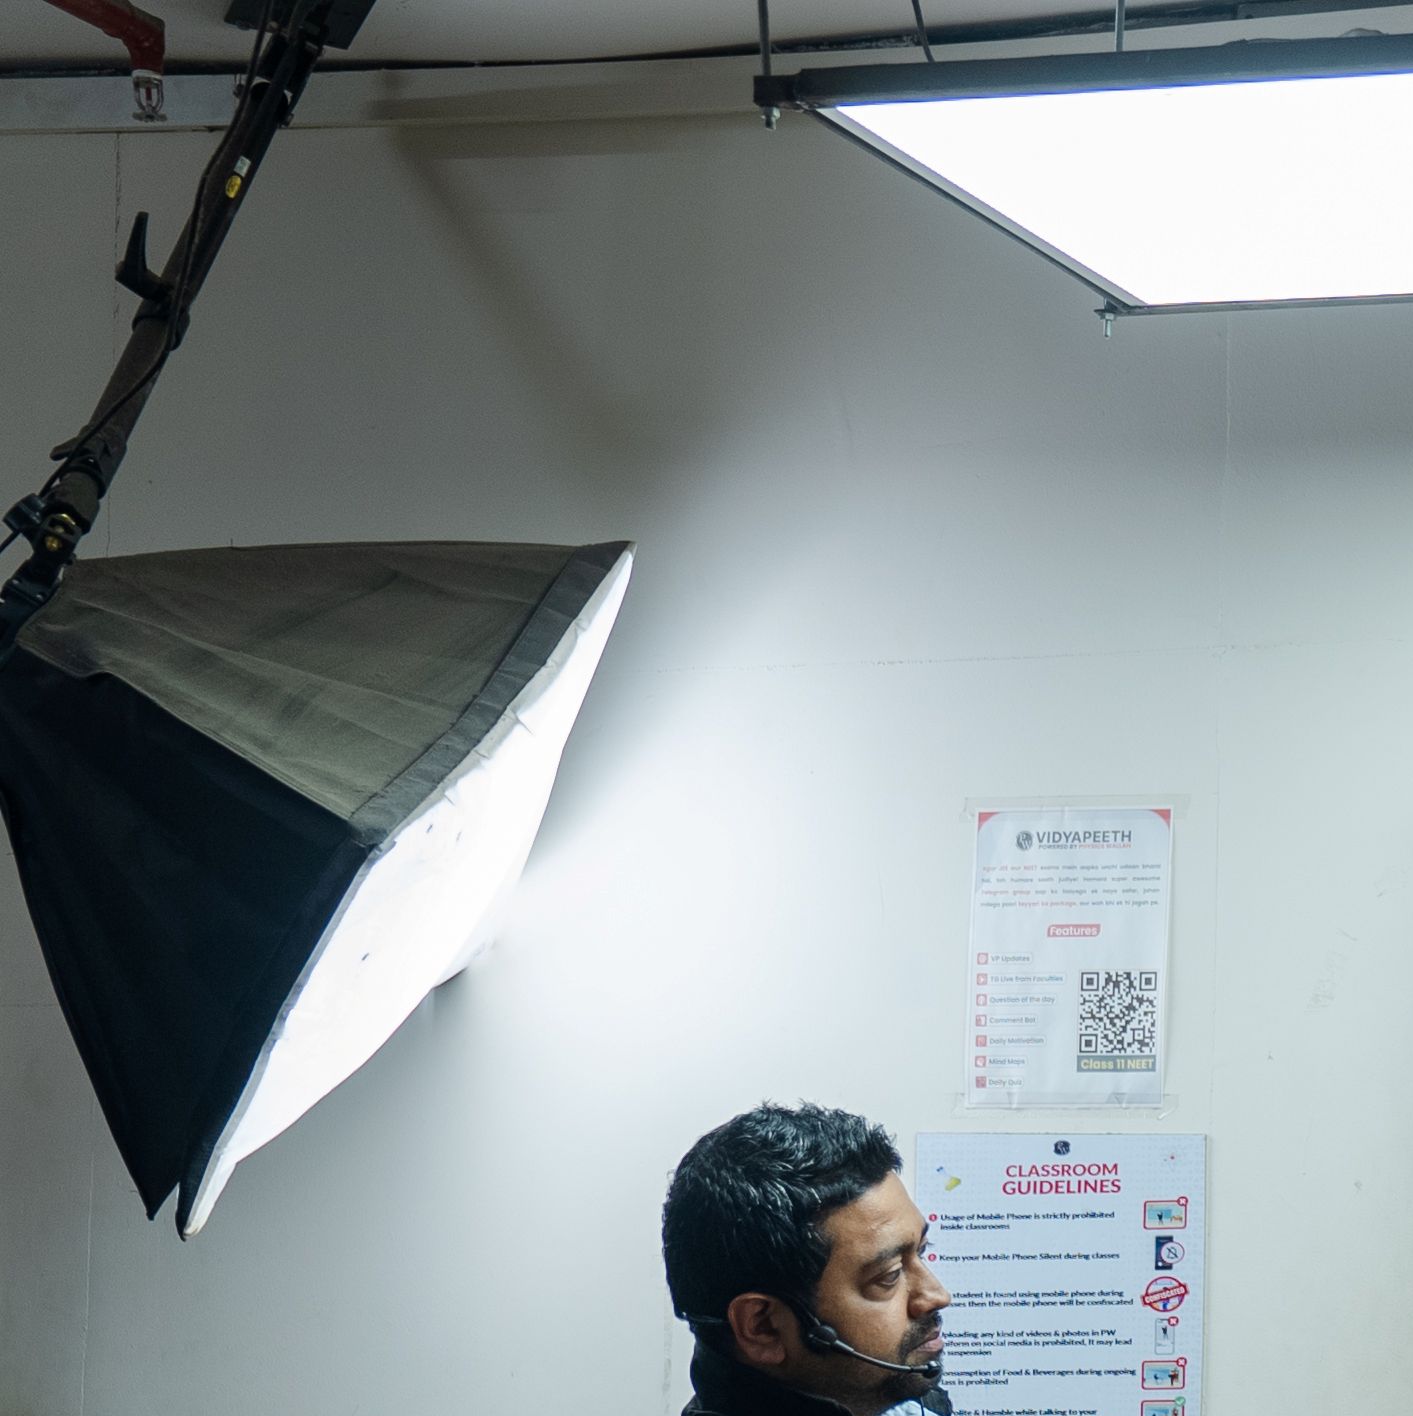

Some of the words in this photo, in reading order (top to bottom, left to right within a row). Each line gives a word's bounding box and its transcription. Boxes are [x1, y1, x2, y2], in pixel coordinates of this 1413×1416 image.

[1036, 830, 1132, 844] VIDYAPEETH
[1049, 926, 1098, 937] Features
[1042, 996, 1055, 1004] day
[1081, 1059, 1113, 1069] Class
[1116, 1059, 1125, 1069] 11
[1127, 1059, 1154, 1069] NEET
[1006, 1163, 1118, 1178] CLASSROOM
[1002, 1179, 1121, 1195] GUIDELINES
[1042, 1212, 1071, 1221] strictly
[1072, 1211, 1115, 1220] prohibited
[939, 1254, 960, 1263] Keep
[1063, 1252, 1090, 1261] during
[1018, 1291, 1040, 1299] using
[1070, 1290, 1096, 1298] phone
[1097, 1289, 1124, 1298] during
[1032, 1300, 1058, 1308] phone
[1061, 1330, 1090, 1338] photos
[1032, 1369, 1074, 1377] Beverages
[1075, 1368, 1102, 1376] during
[1103, 1368, 1136, 1376] ongoing
